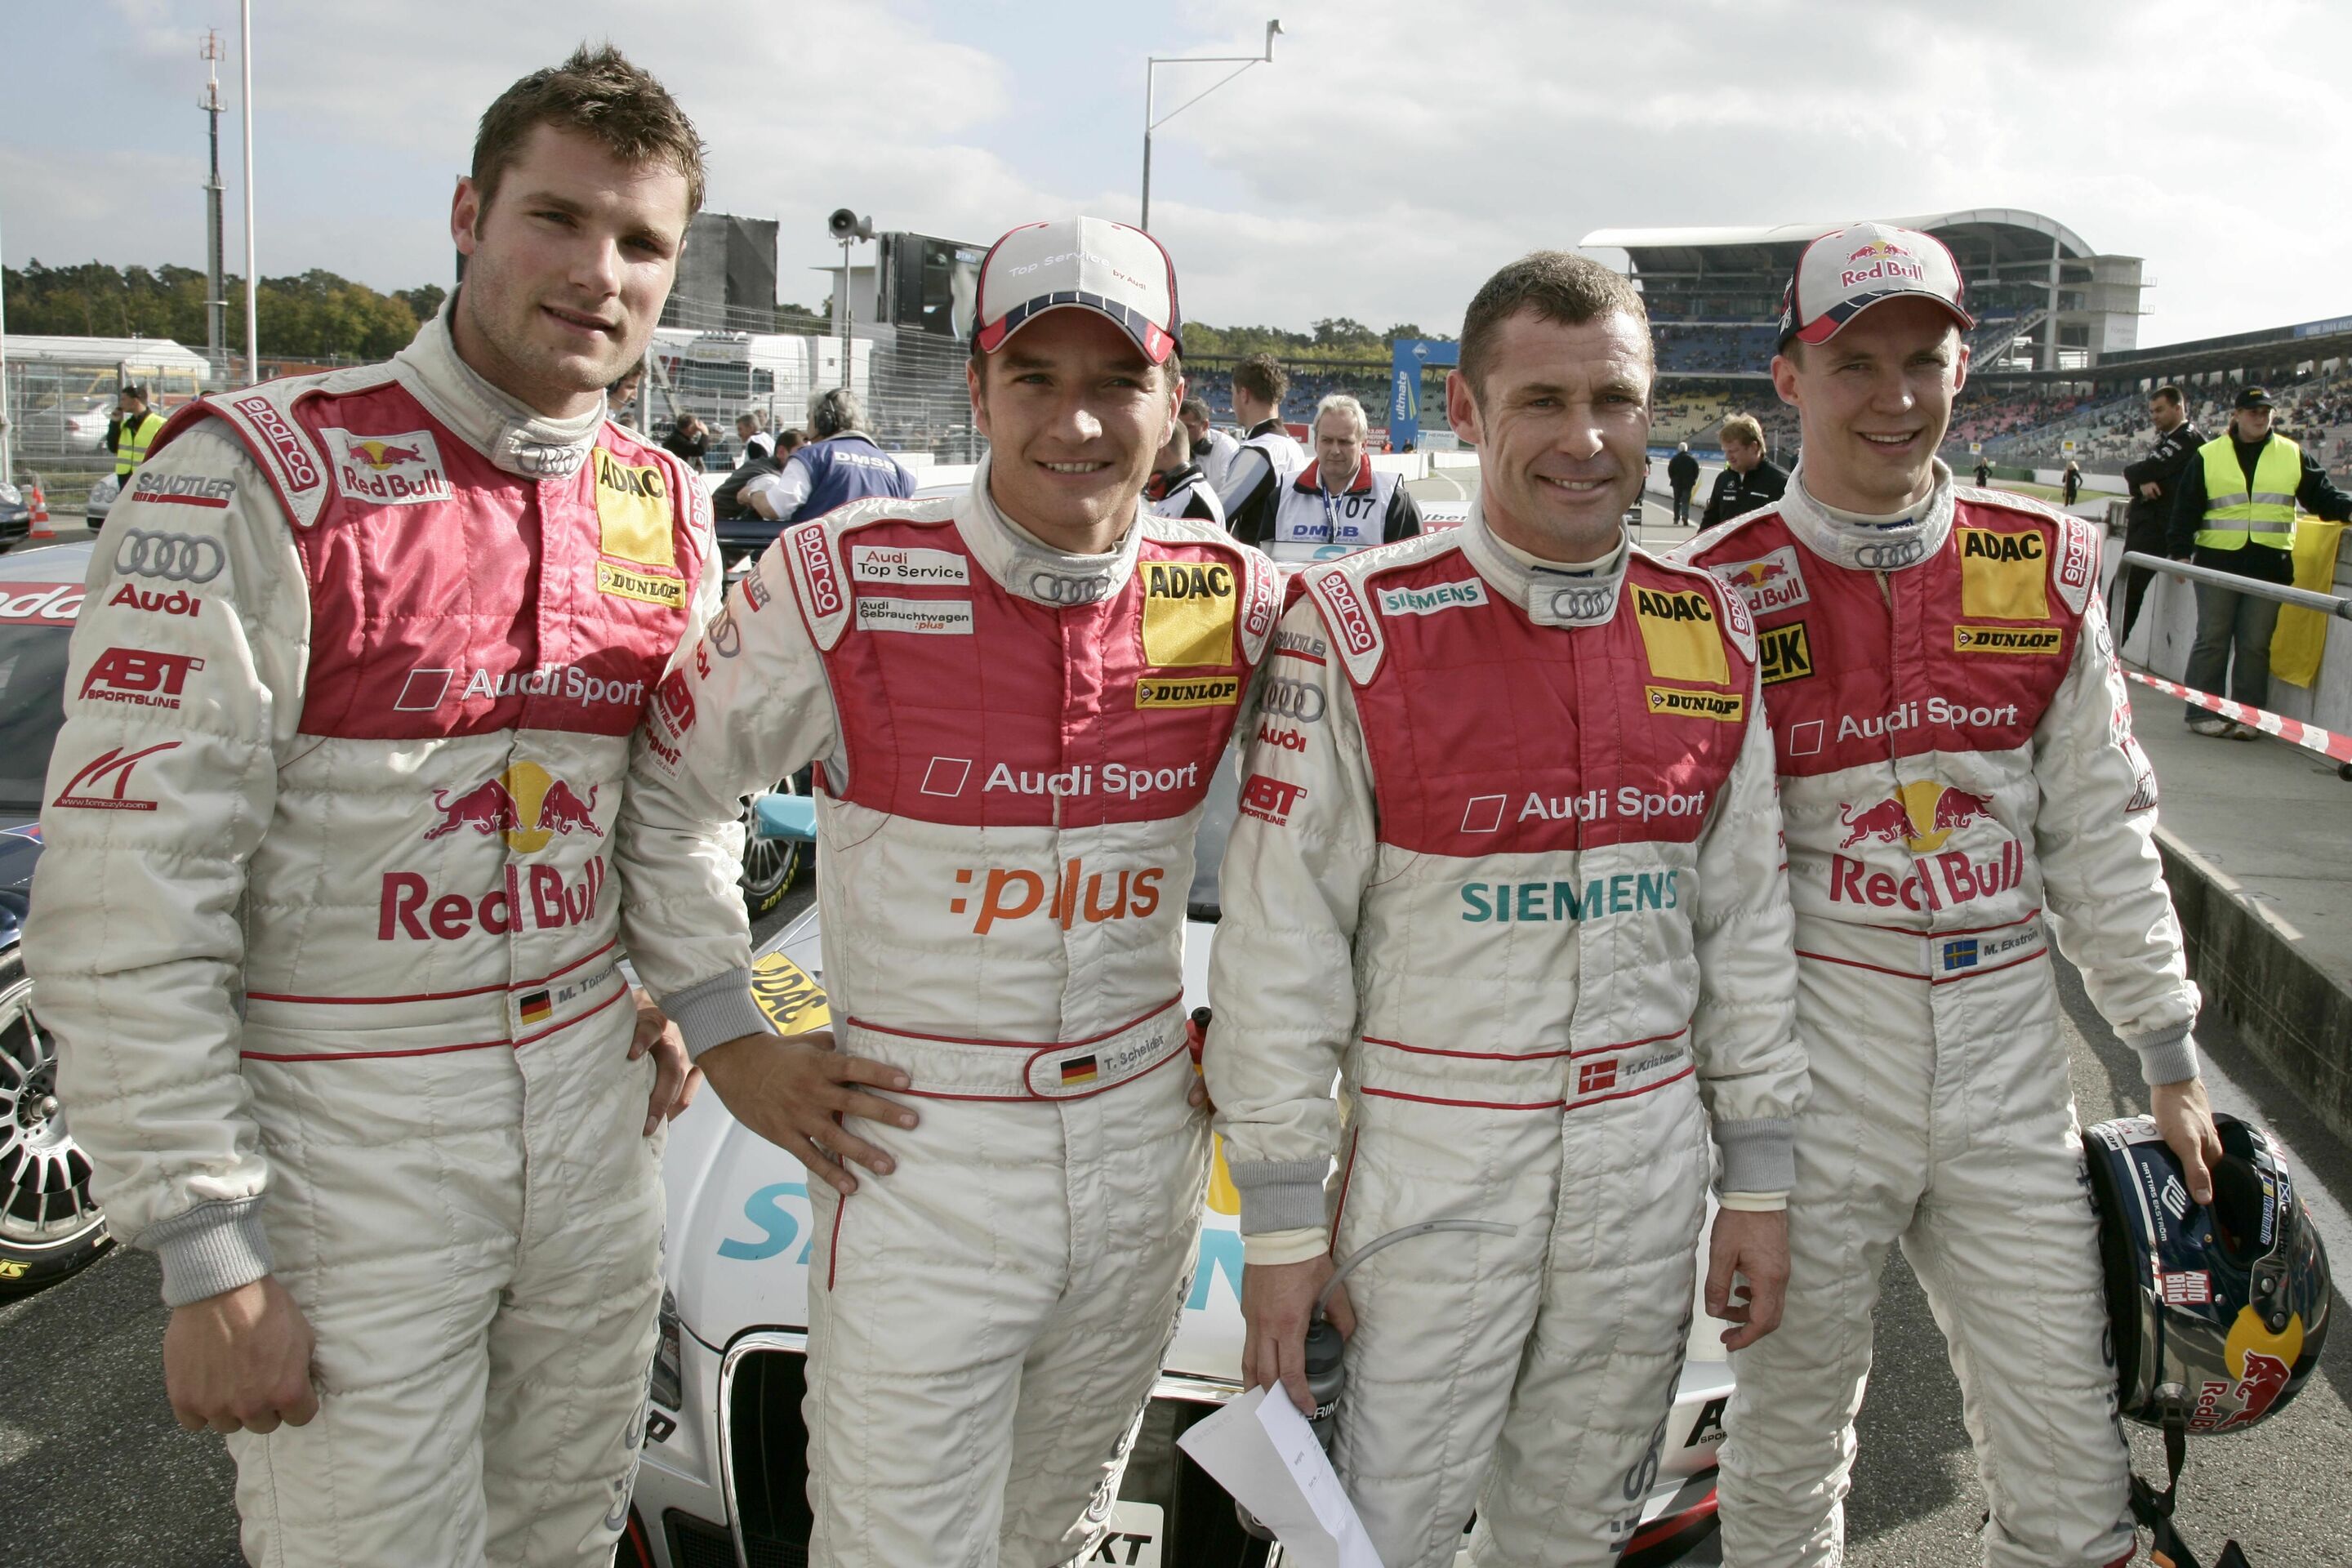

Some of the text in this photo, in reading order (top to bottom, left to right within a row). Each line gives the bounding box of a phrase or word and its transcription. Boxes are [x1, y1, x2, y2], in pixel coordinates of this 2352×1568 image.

[1009, 251, 1111, 278] Top Service
[1112, 269, 1147, 291] by Audi
[1841, 261, 1925, 288] Red Bull
[1396, 371, 1407, 421] ultimate
[245, 398, 316, 488] sparco
[834, 451, 898, 473] DMSB
[342, 466, 443, 498] Red Bull
[599, 458, 665, 499] ADAC
[1345, 497, 1376, 520] 07
[866, 550, 908, 564] Audi
[1964, 531, 2042, 563] ADAC
[2064, 519, 2089, 586] sparco
[612, 573, 681, 600] DUNLOP
[798, 527, 840, 614] sparco
[858, 563, 964, 579] Top Service
[1150, 565, 1232, 599] ADAC
[109, 583, 201, 617] Audi
[860, 600, 889, 610] Audi
[1387, 585, 1479, 612] SIEMENS
[1638, 590, 1713, 622] ADAC
[1762, 577, 1802, 608] Bull
[860, 608, 969, 624] Gebrauchtwagen
[1320, 573, 1374, 651] sparco
[1759, 628, 1809, 674] UK
[1973, 630, 2059, 650] DUNLOP
[78, 646, 205, 701] ABT
[461, 665, 644, 708] Audi Sport
[87, 689, 180, 710] SPORTSLINE
[1155, 681, 1237, 702] DUNLOP
[1666, 694, 1740, 715] DUNLOP
[1836, 697, 2018, 743] Audi Sport
[1258, 721, 1307, 753] Audi
[983, 760, 1197, 800] Audi Sport
[1239, 773, 1308, 817] ABT
[1517, 786, 1705, 823] Audi Sport
[1829, 838, 2024, 911] Red Bull
[378, 855, 605, 941] Red Bull
[950, 858, 1165, 935] :plus
[1461, 869, 1678, 923] SIEMENS
[1984, 943, 1998, 956] M.
[558, 985, 577, 1004] M.
[1103, 1033, 1166, 1071] T. Scheider
[1625, 1063, 1637, 1076] T.
[2259, 1195, 2274, 1245] Westmatic
[2164, 1273, 2187, 1304] Bild
[2184, 1271, 2208, 1303] Auto
[2194, 1380, 2230, 1419] Red
